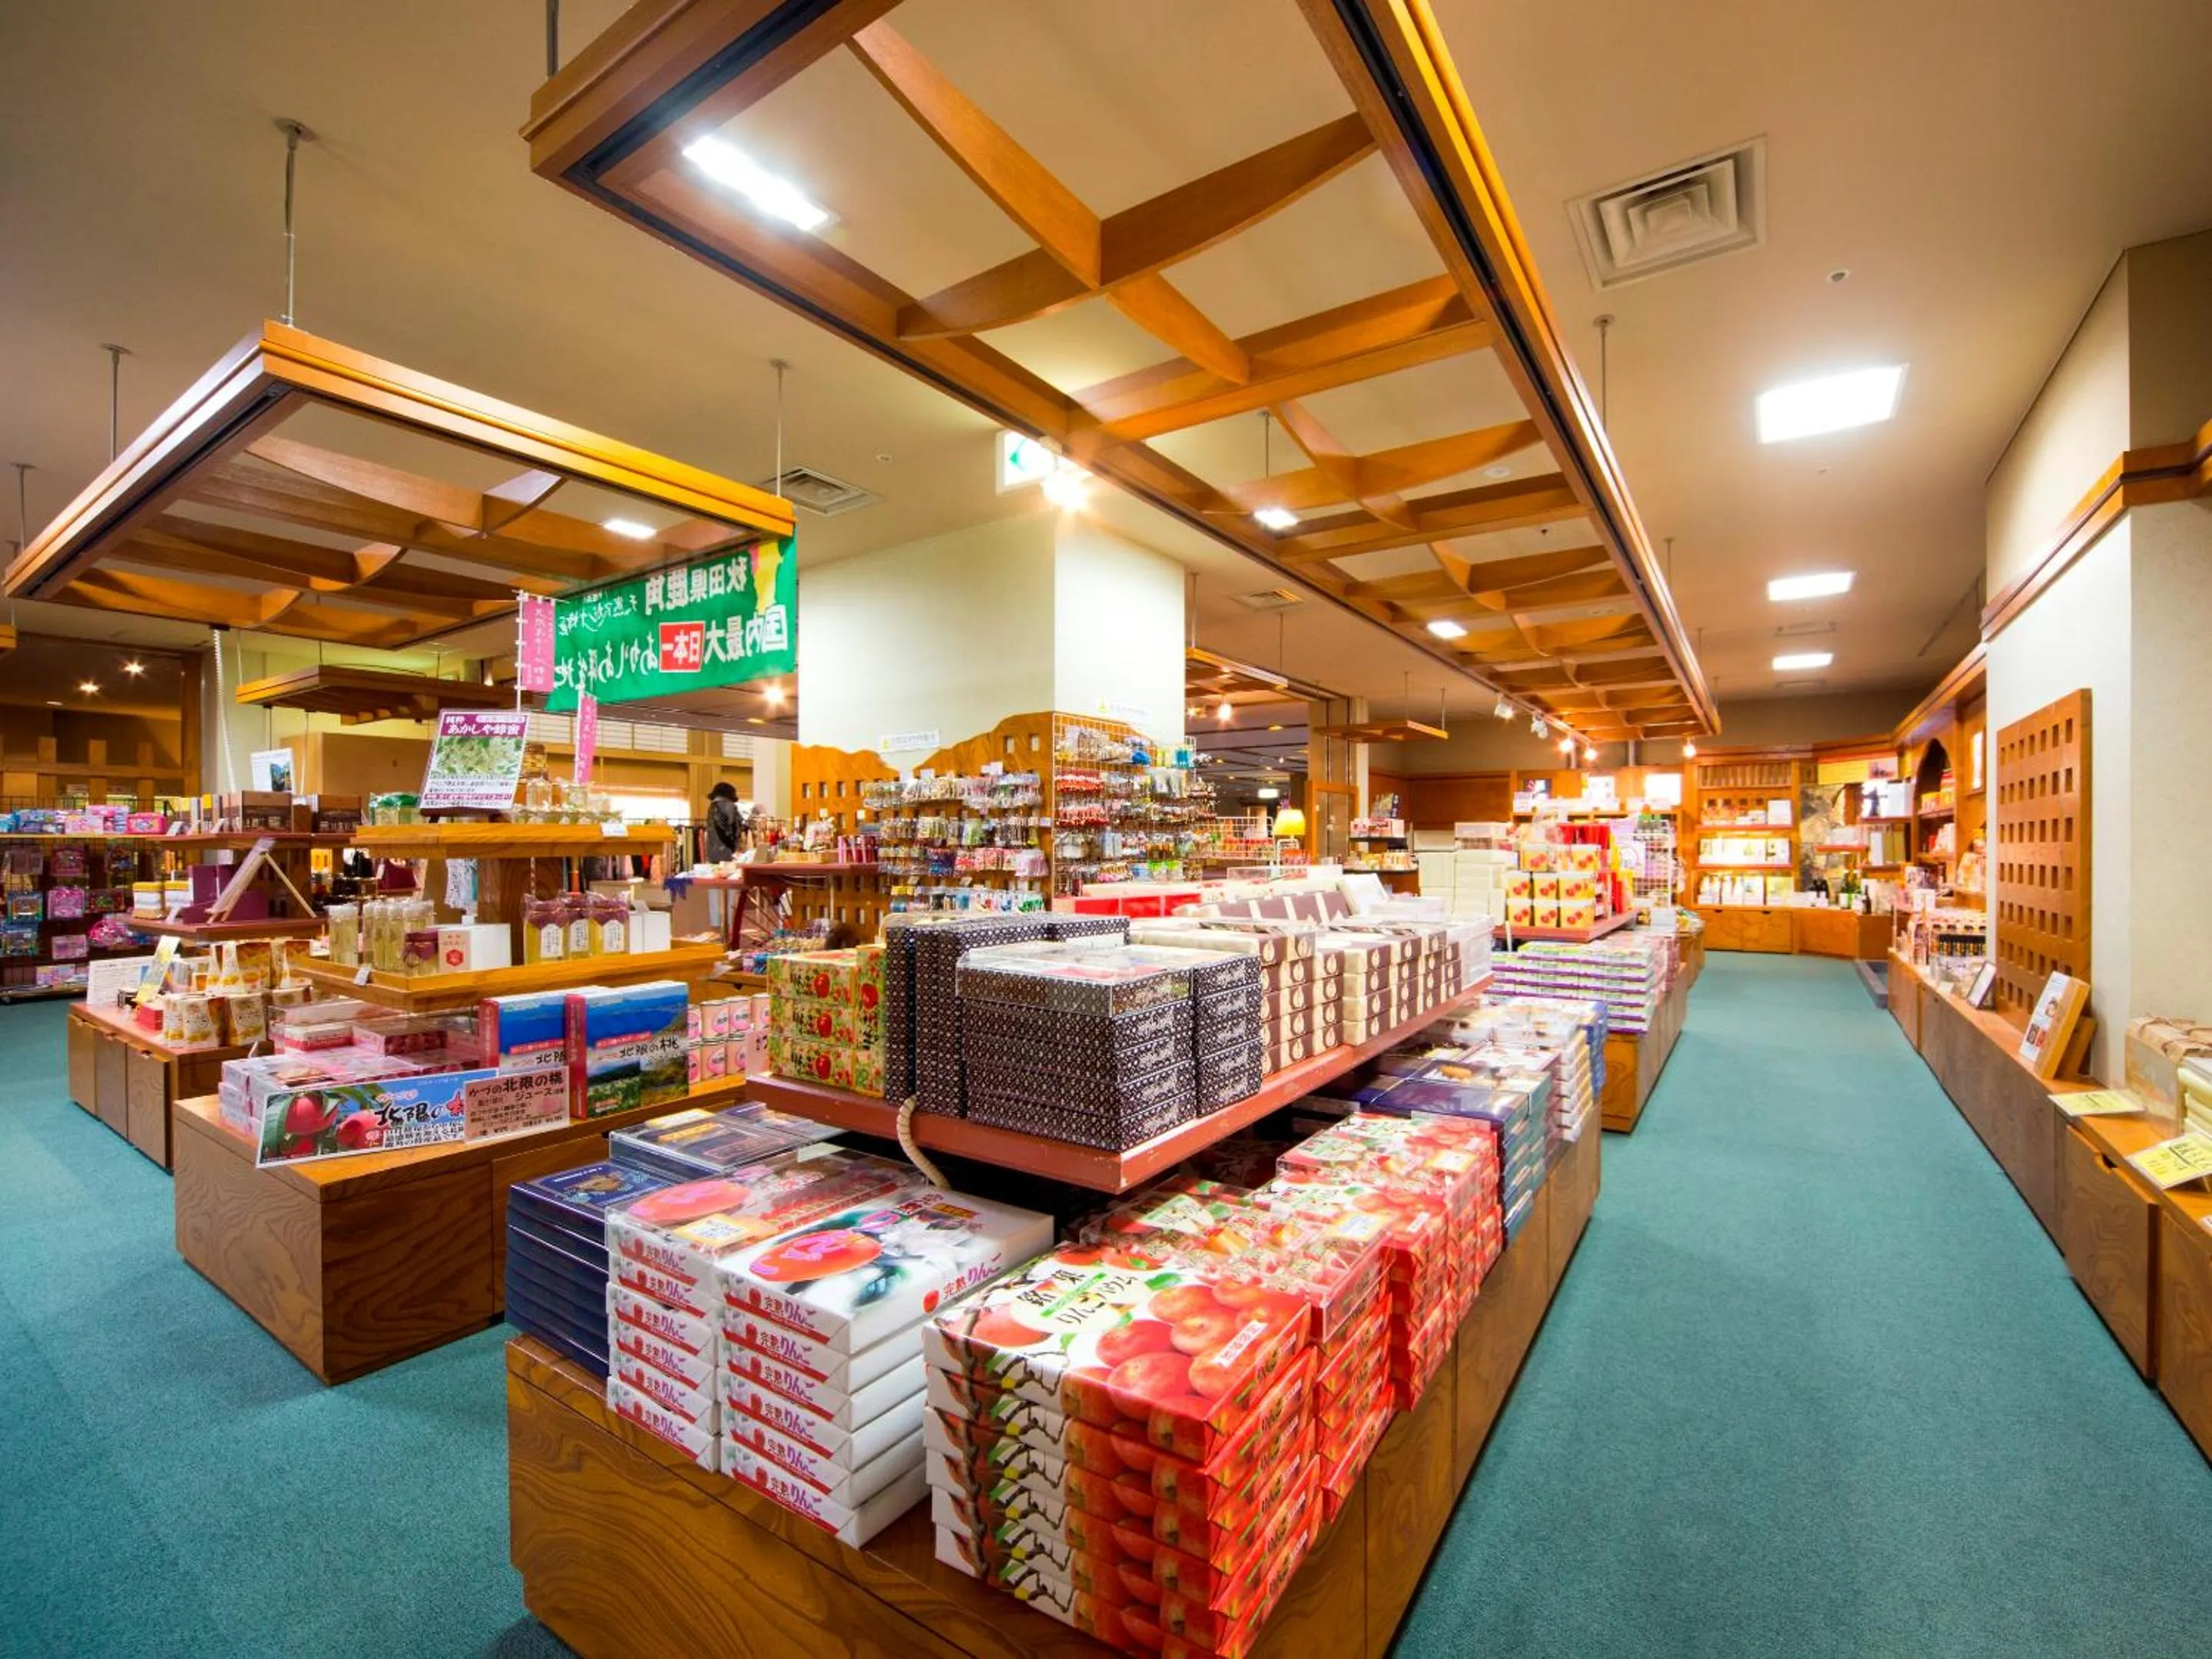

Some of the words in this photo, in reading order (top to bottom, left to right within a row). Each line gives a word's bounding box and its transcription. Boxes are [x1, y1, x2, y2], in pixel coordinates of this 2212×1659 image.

[448, 724, 520, 735] あかしや蜂蜜
[620, 1036, 680, 1058] 北限の桃
[515, 1088, 552, 1101] ジュース
